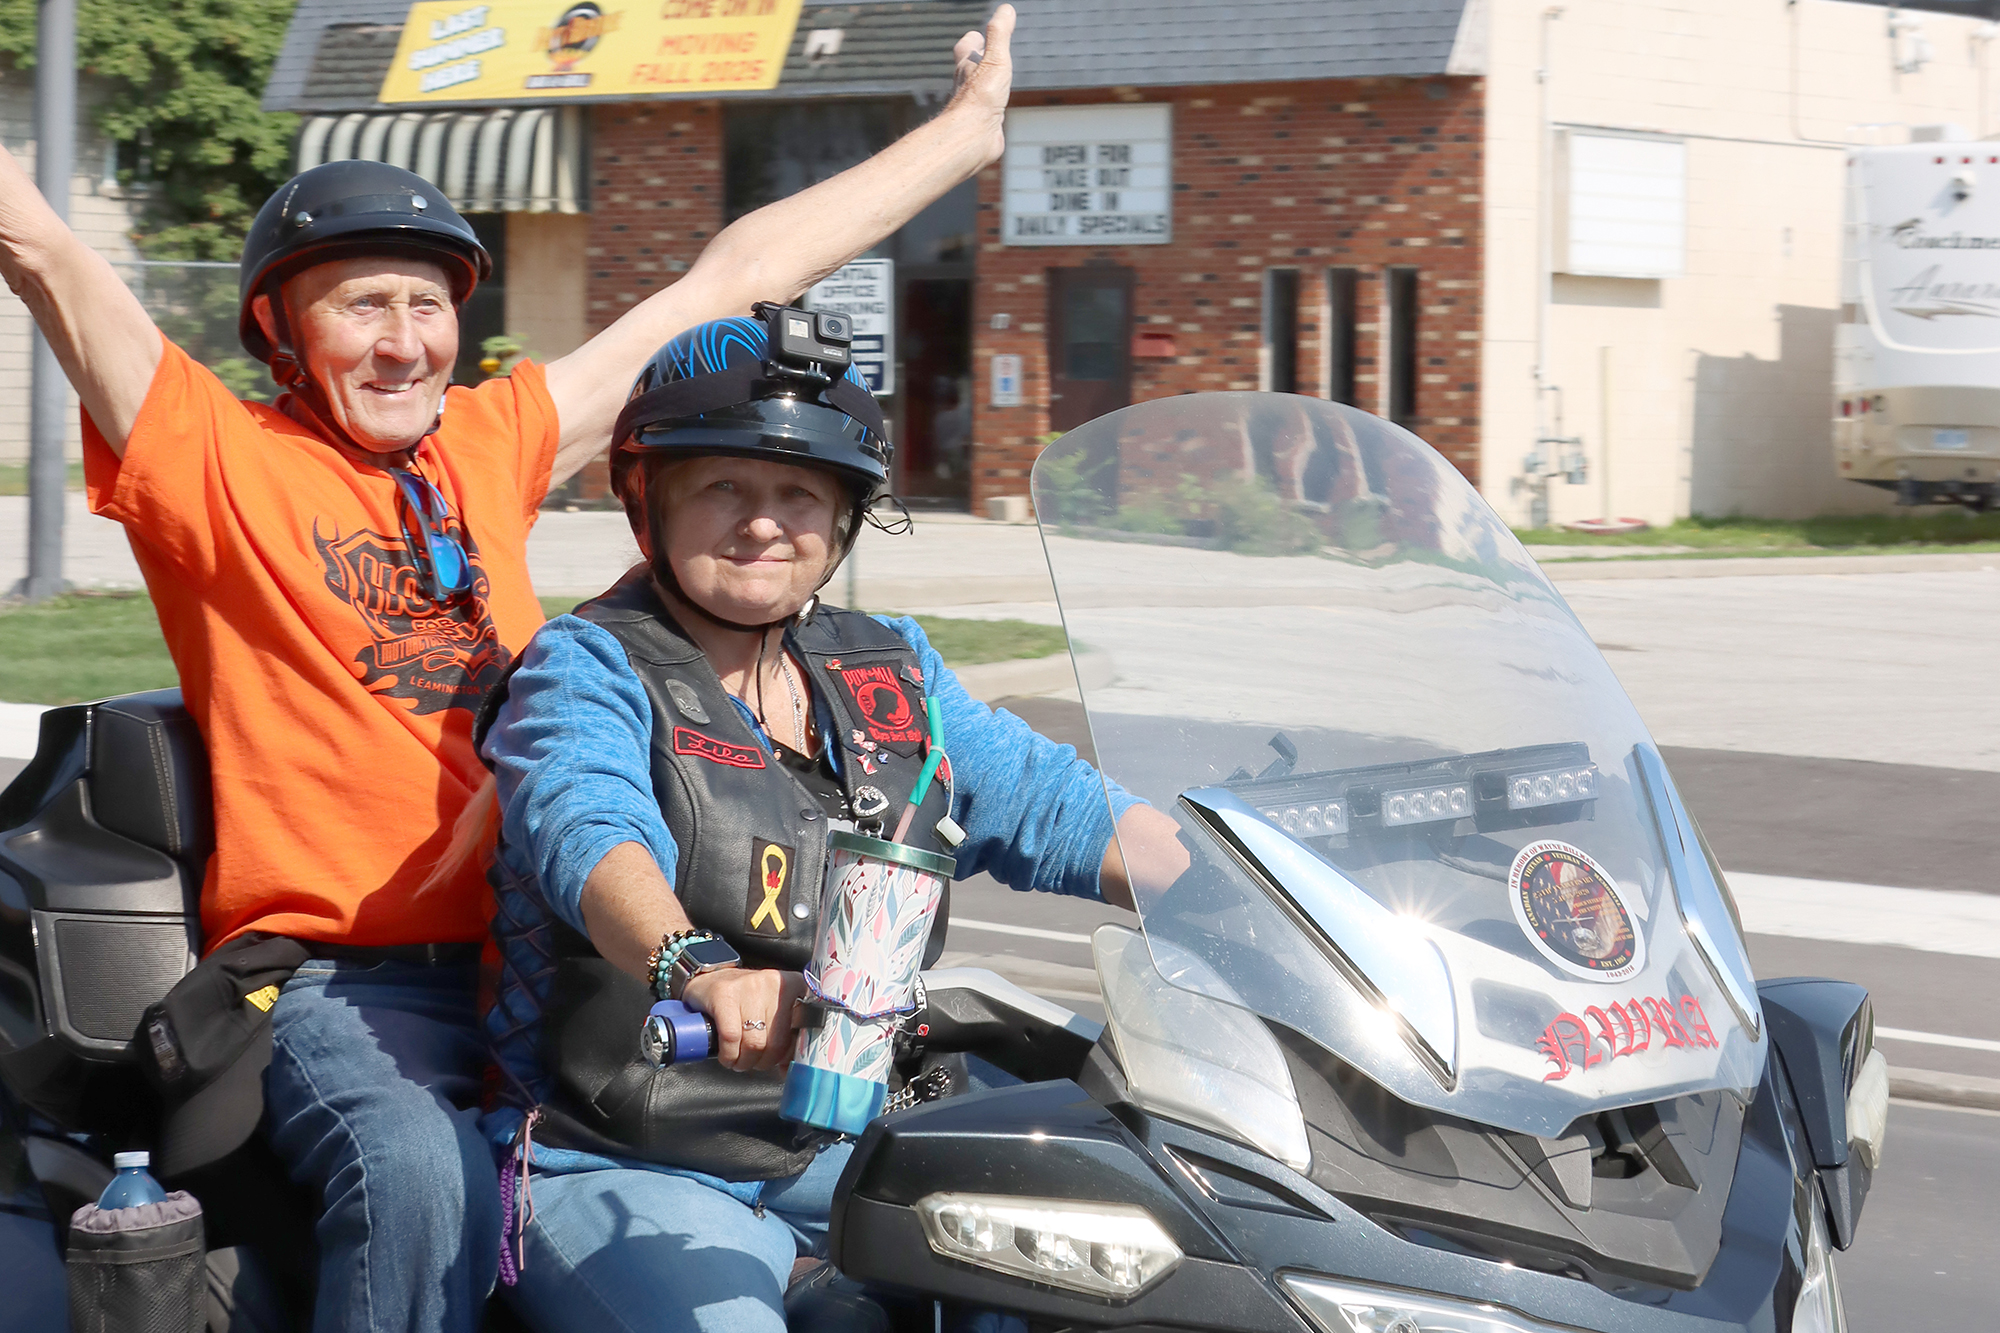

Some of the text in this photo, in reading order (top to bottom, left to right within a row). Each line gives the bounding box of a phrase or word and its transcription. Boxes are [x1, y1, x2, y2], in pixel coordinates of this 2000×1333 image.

[657, 32, 758, 56] MOVING
[629, 59, 768, 85] FALL 2025
[1043, 144, 1131, 165] OPEN FOR
[1043, 168, 1131, 188] TAKE OUT
[1051, 191, 1118, 212] DINE IN
[1016, 214, 1167, 236] DAILY SPECIALS
[823, 267, 878, 281] ENTAL
[823, 284, 877, 298] OFFICE
[1510, 842, 1596, 889] IN MEMORY OF WAYNE HILLMAN
[1523, 855, 1544, 878] VIETNAM
[1551, 852, 1580, 866] VETERAN
